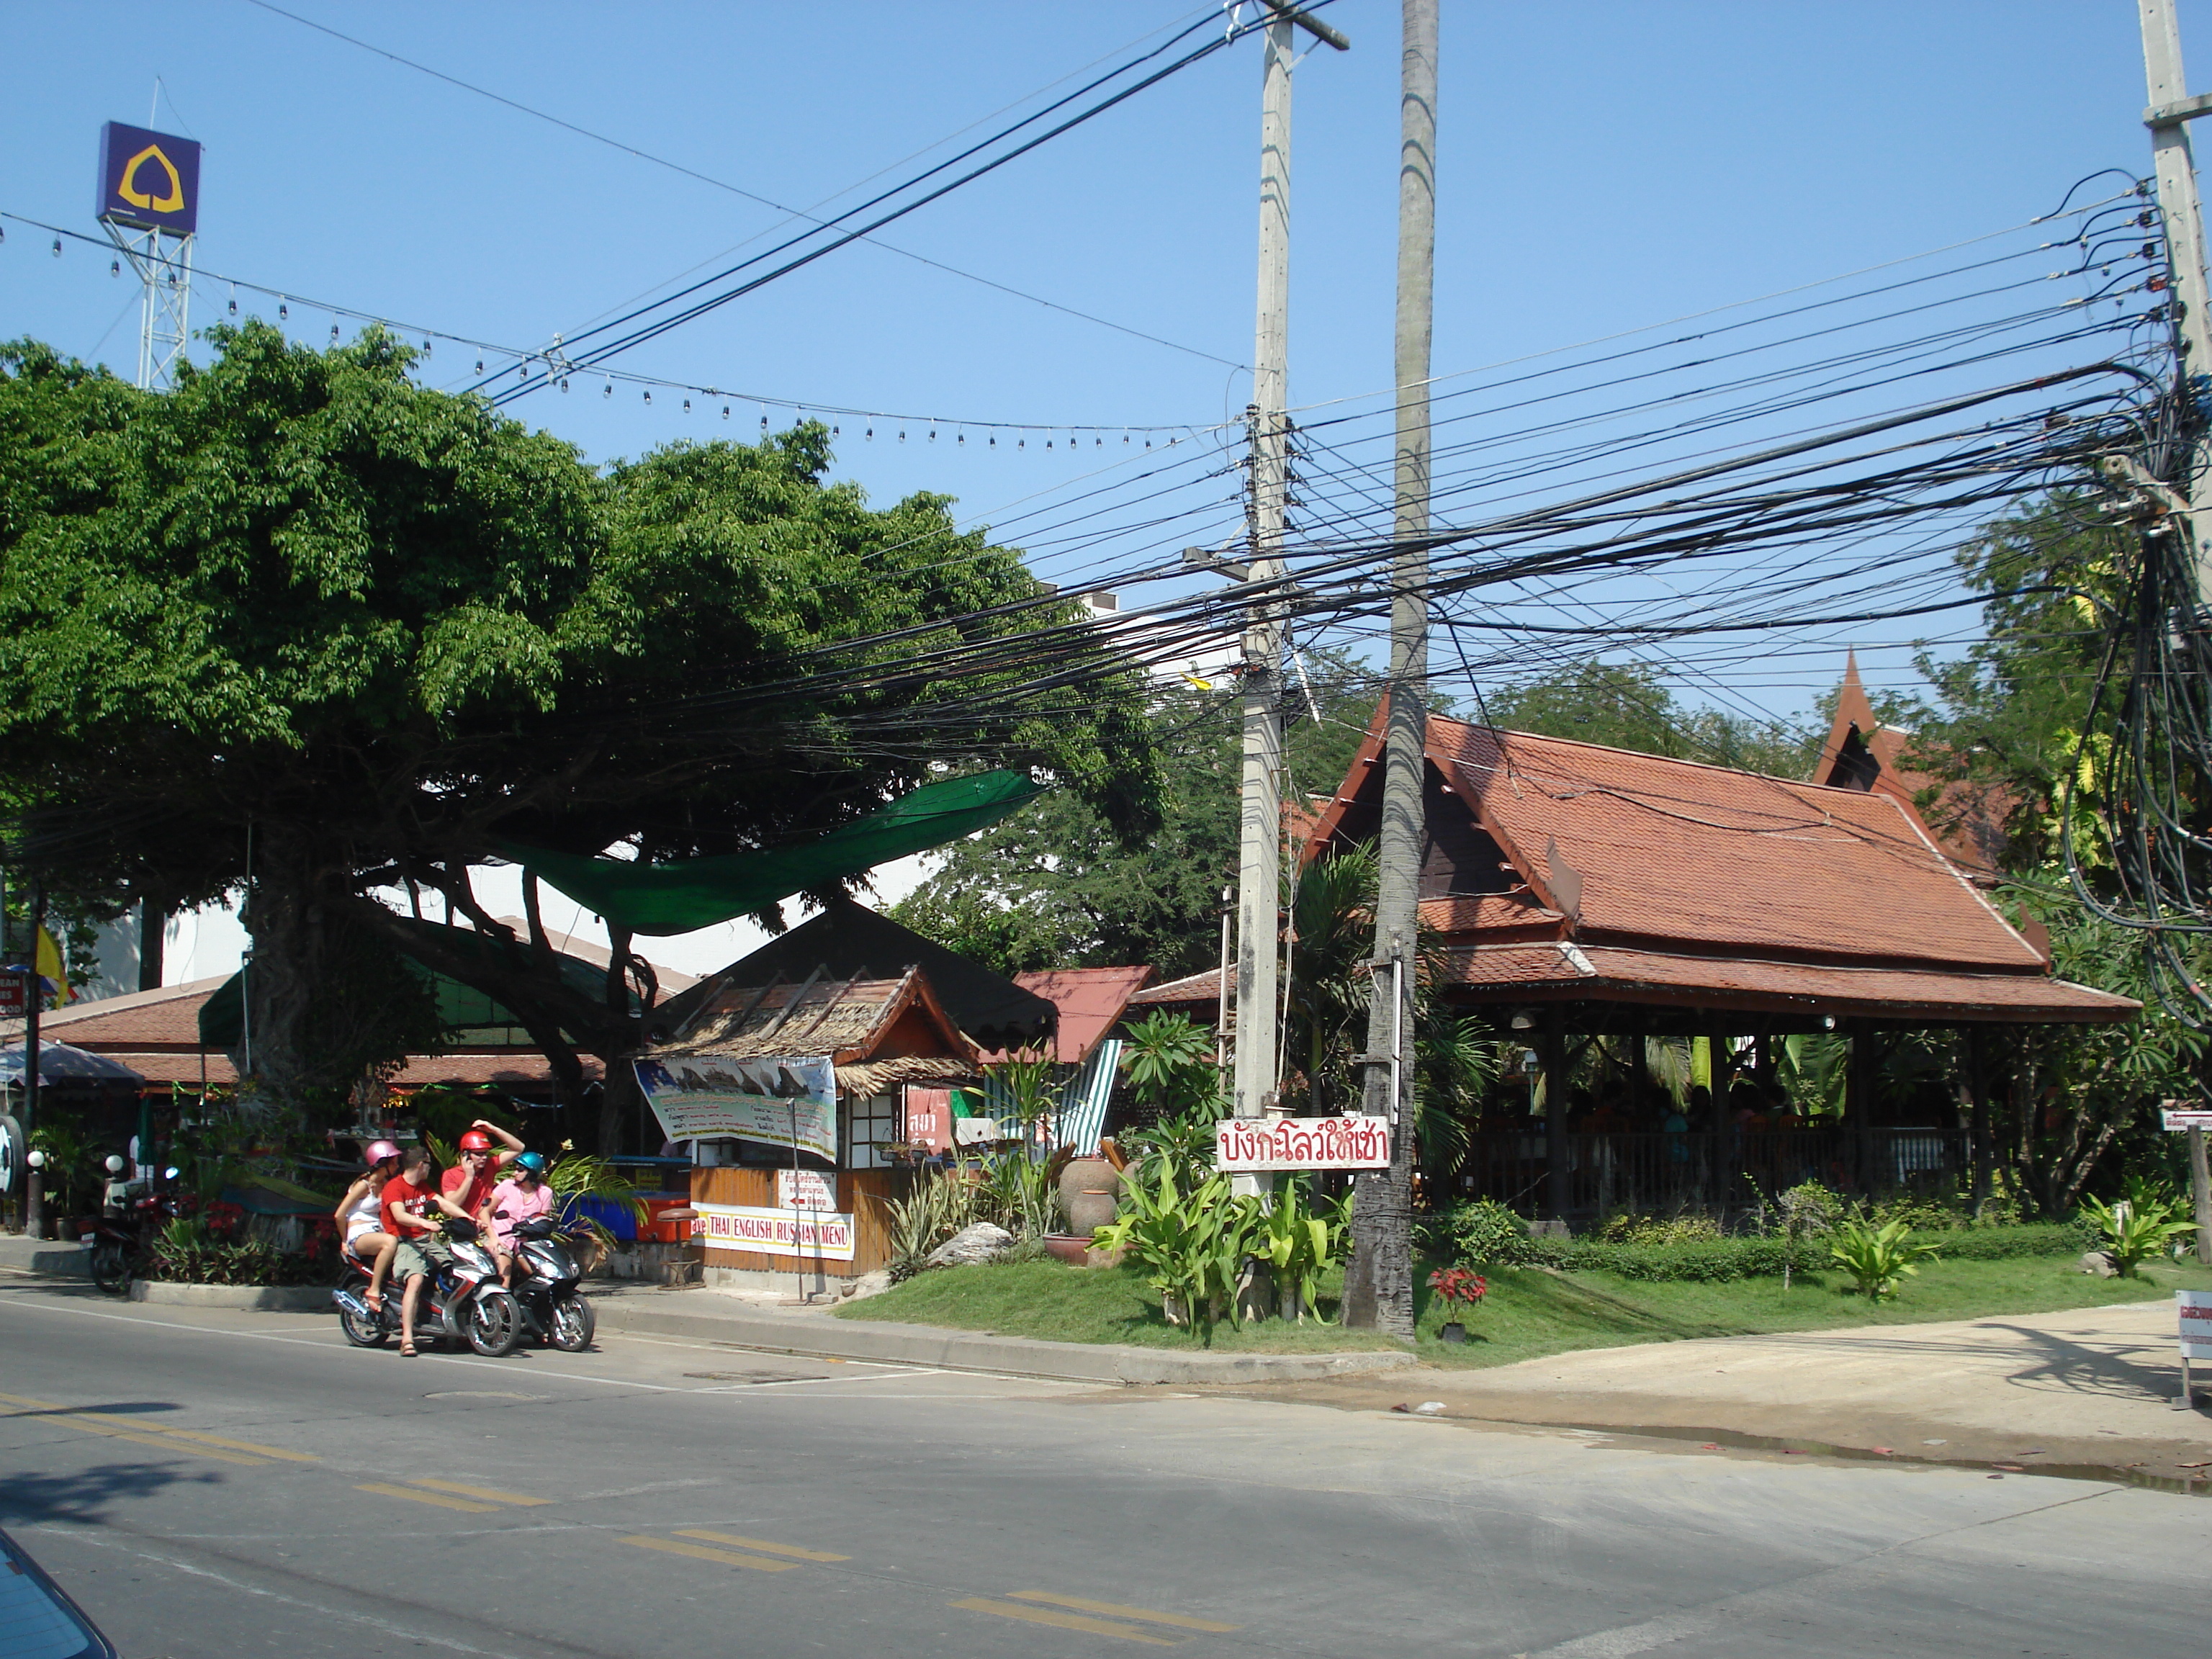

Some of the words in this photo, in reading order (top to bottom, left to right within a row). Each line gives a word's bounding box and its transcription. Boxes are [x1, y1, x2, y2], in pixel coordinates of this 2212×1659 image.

[909, 1114, 935, 1136] สุขา
[1220, 1119, 1388, 1161] บังกะโลว์ให้เช่า
[710, 1216, 729, 1235] THAI
[734, 1219, 772, 1240] ENGLISH
[821, 1225, 848, 1246] MENU
